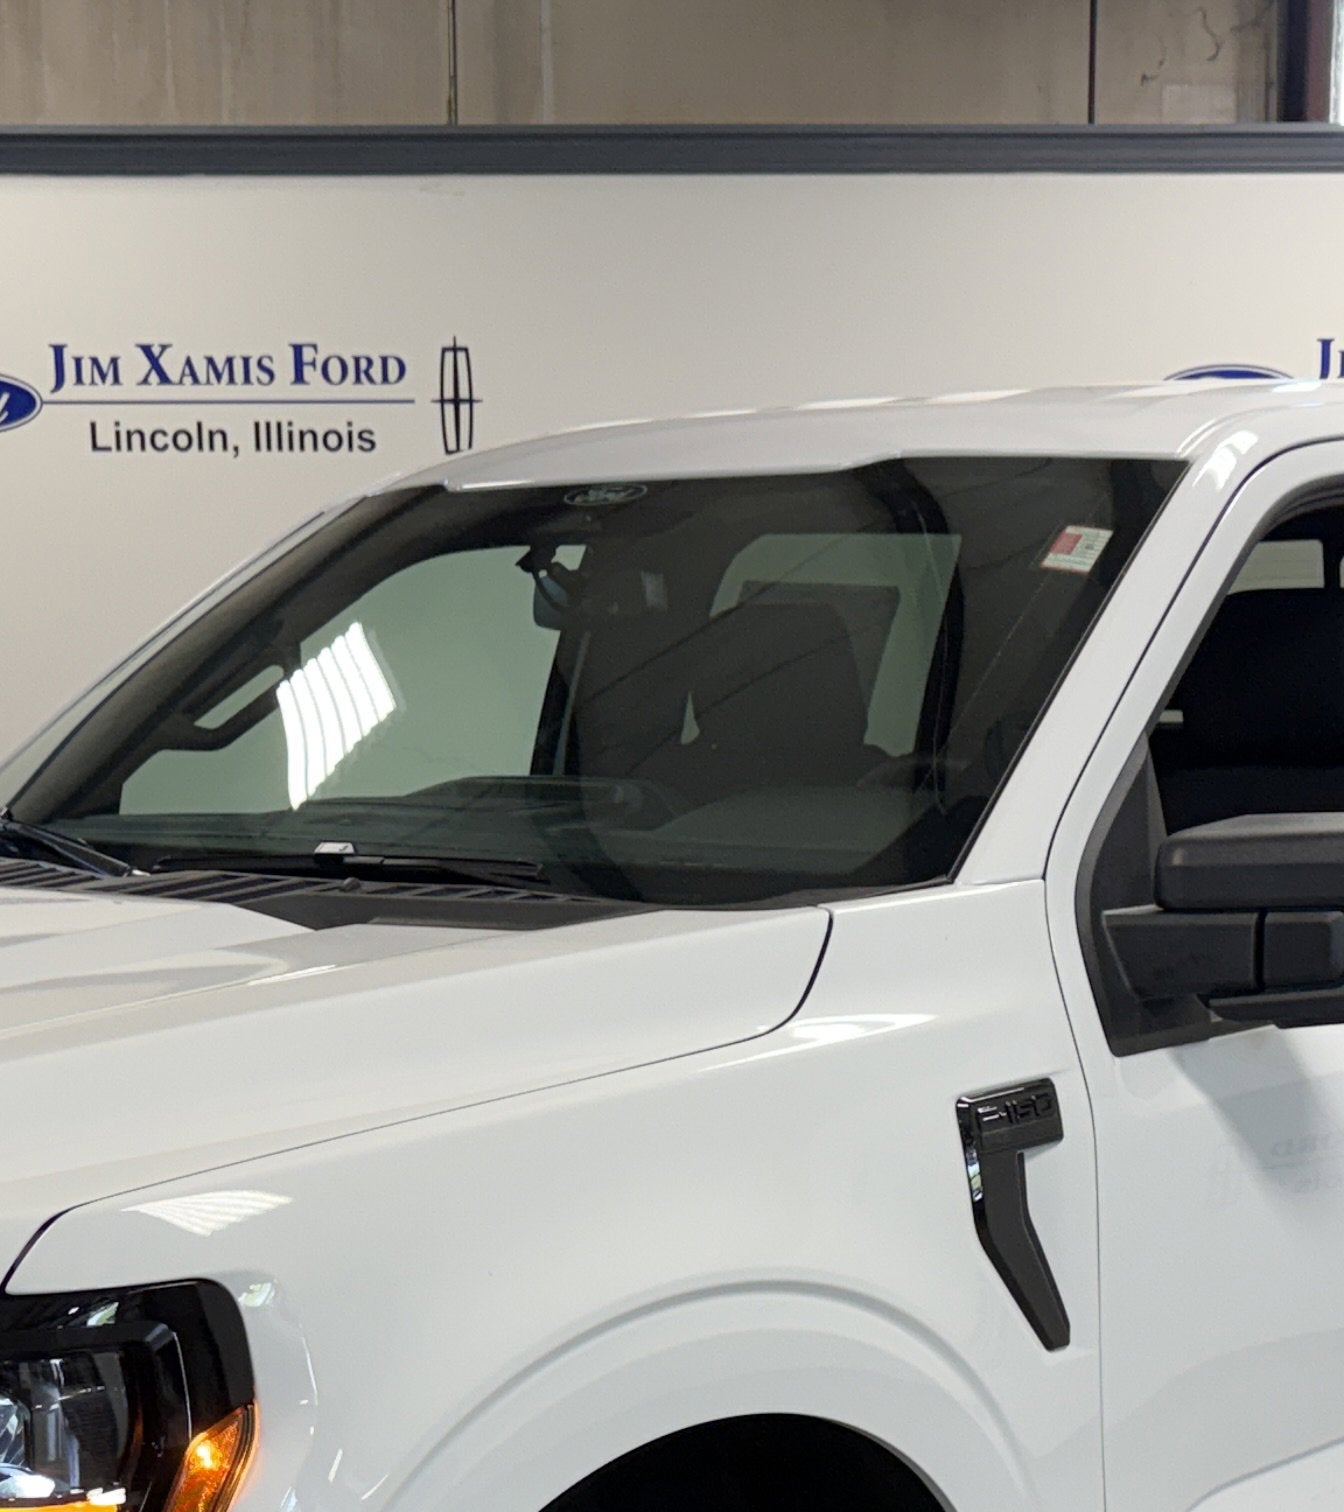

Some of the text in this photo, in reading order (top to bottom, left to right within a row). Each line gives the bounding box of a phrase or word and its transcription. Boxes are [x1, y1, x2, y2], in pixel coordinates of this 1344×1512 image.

[48, 342, 407, 394] JIM XAMIS FORD
[90, 420, 377, 458] Lincoln, Illinois
